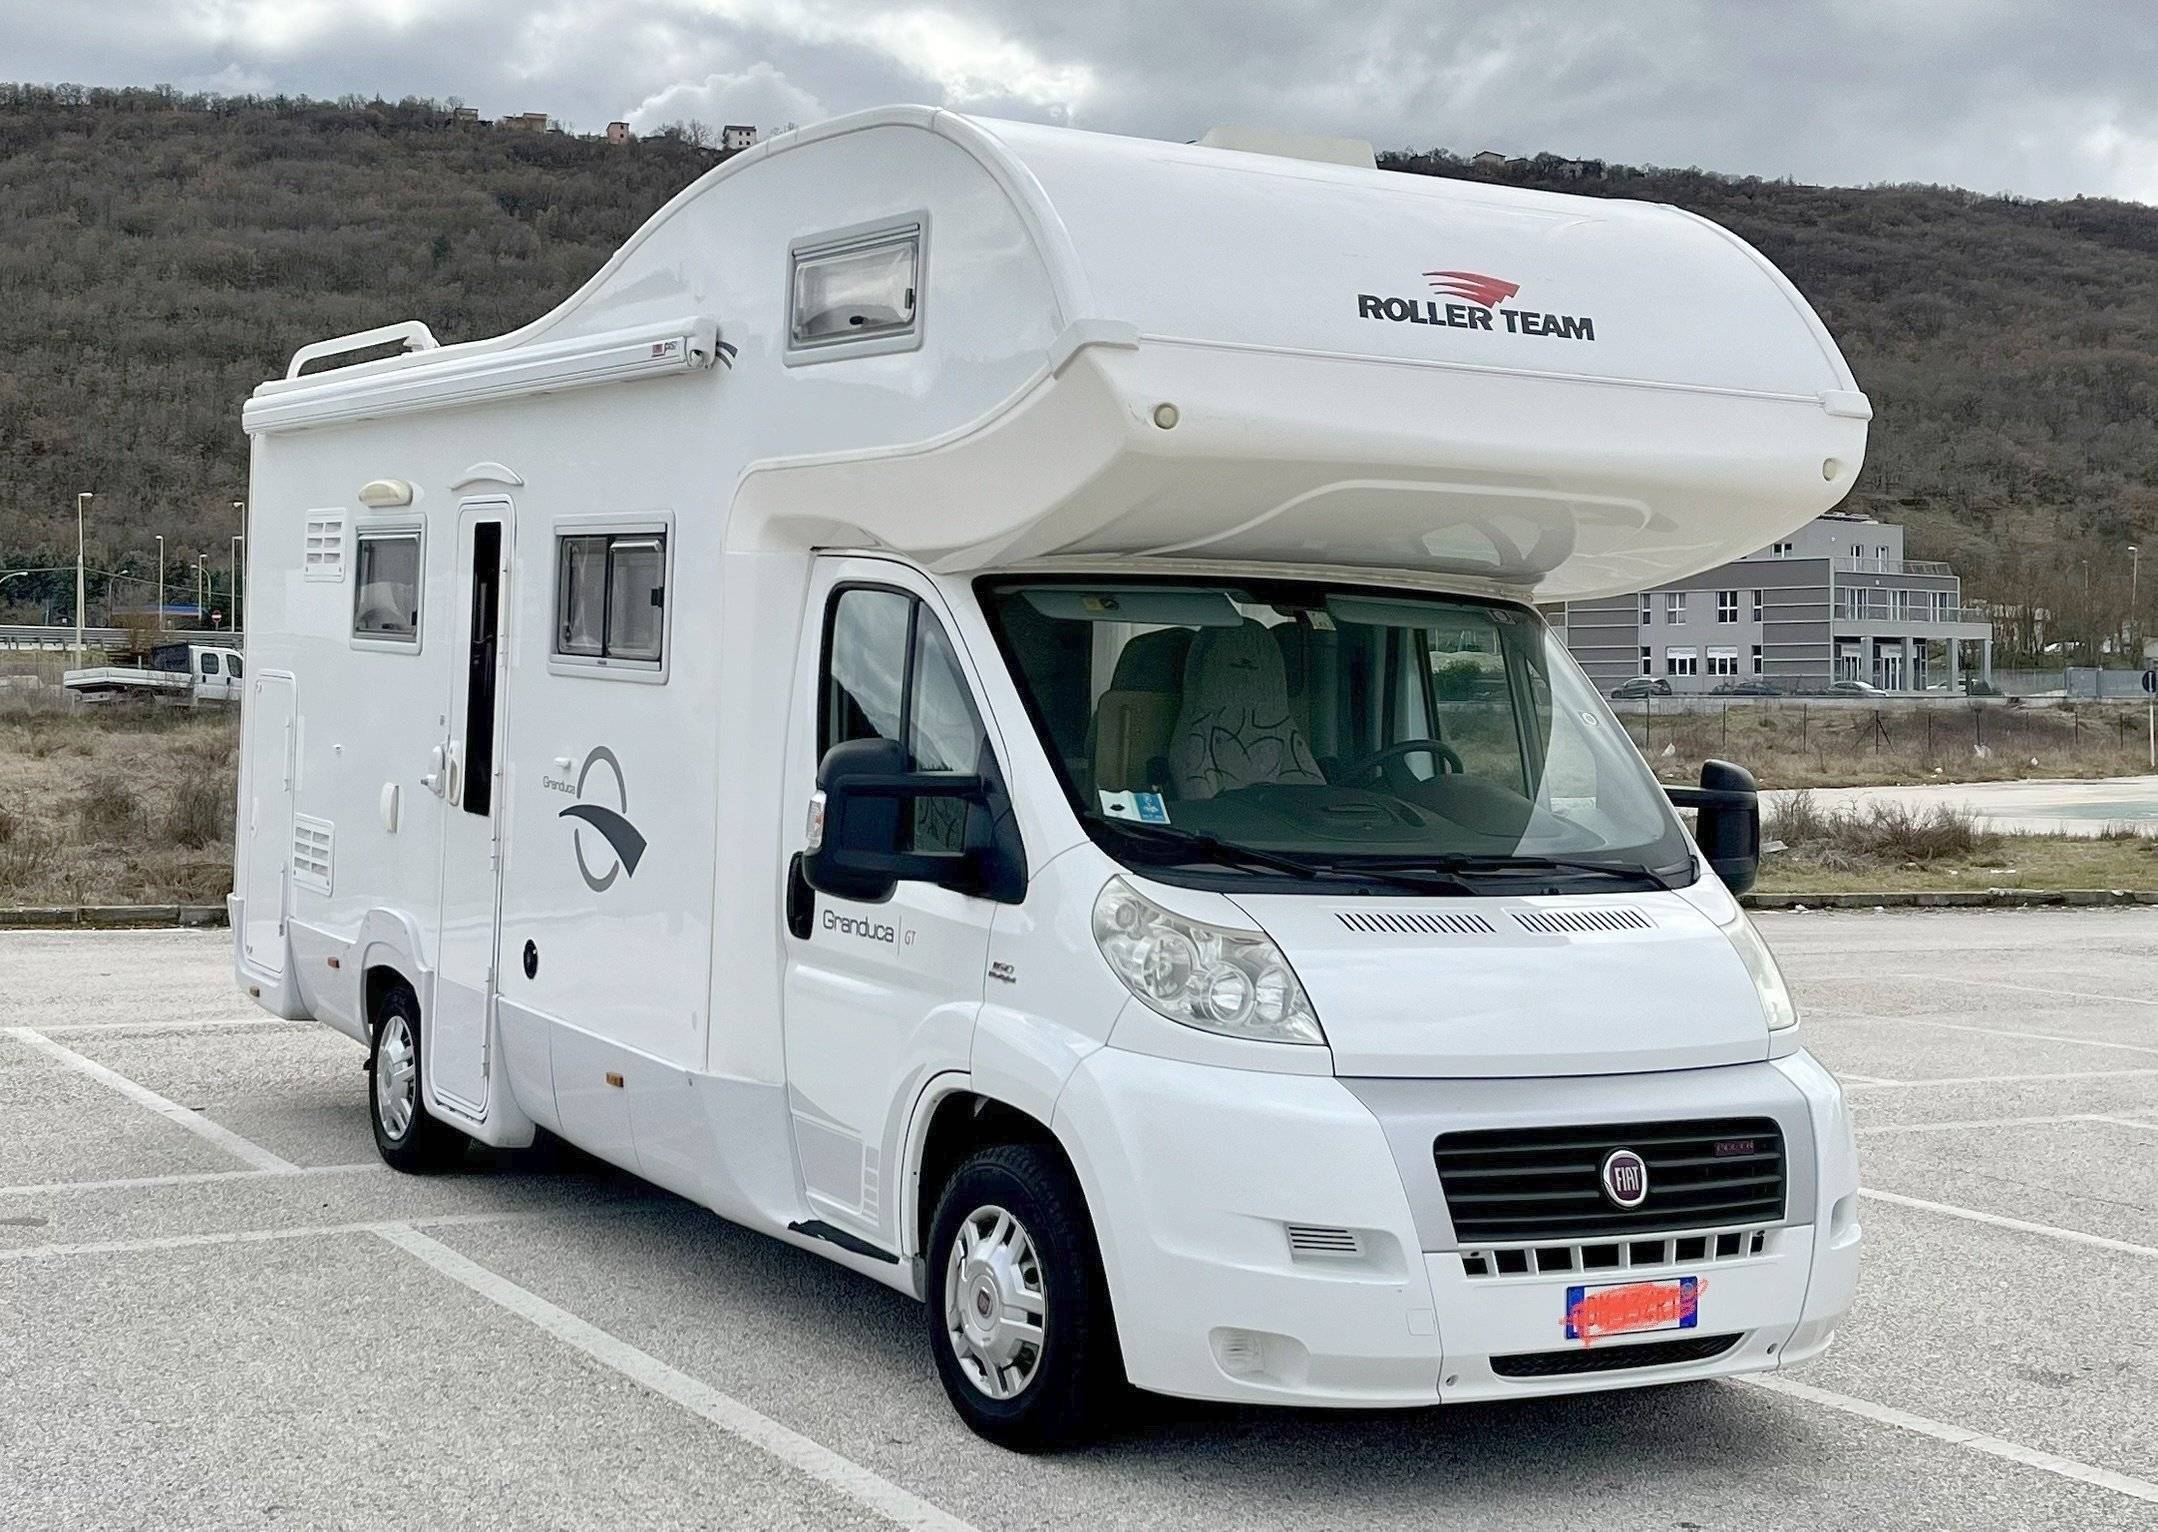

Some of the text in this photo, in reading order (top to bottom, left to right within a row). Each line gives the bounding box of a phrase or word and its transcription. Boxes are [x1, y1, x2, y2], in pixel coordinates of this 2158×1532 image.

[1357, 293, 1596, 341] ROLLER TEAM
[822, 909, 917, 946] Granduca GT
[1614, 1166, 1640, 1192] FIAT
